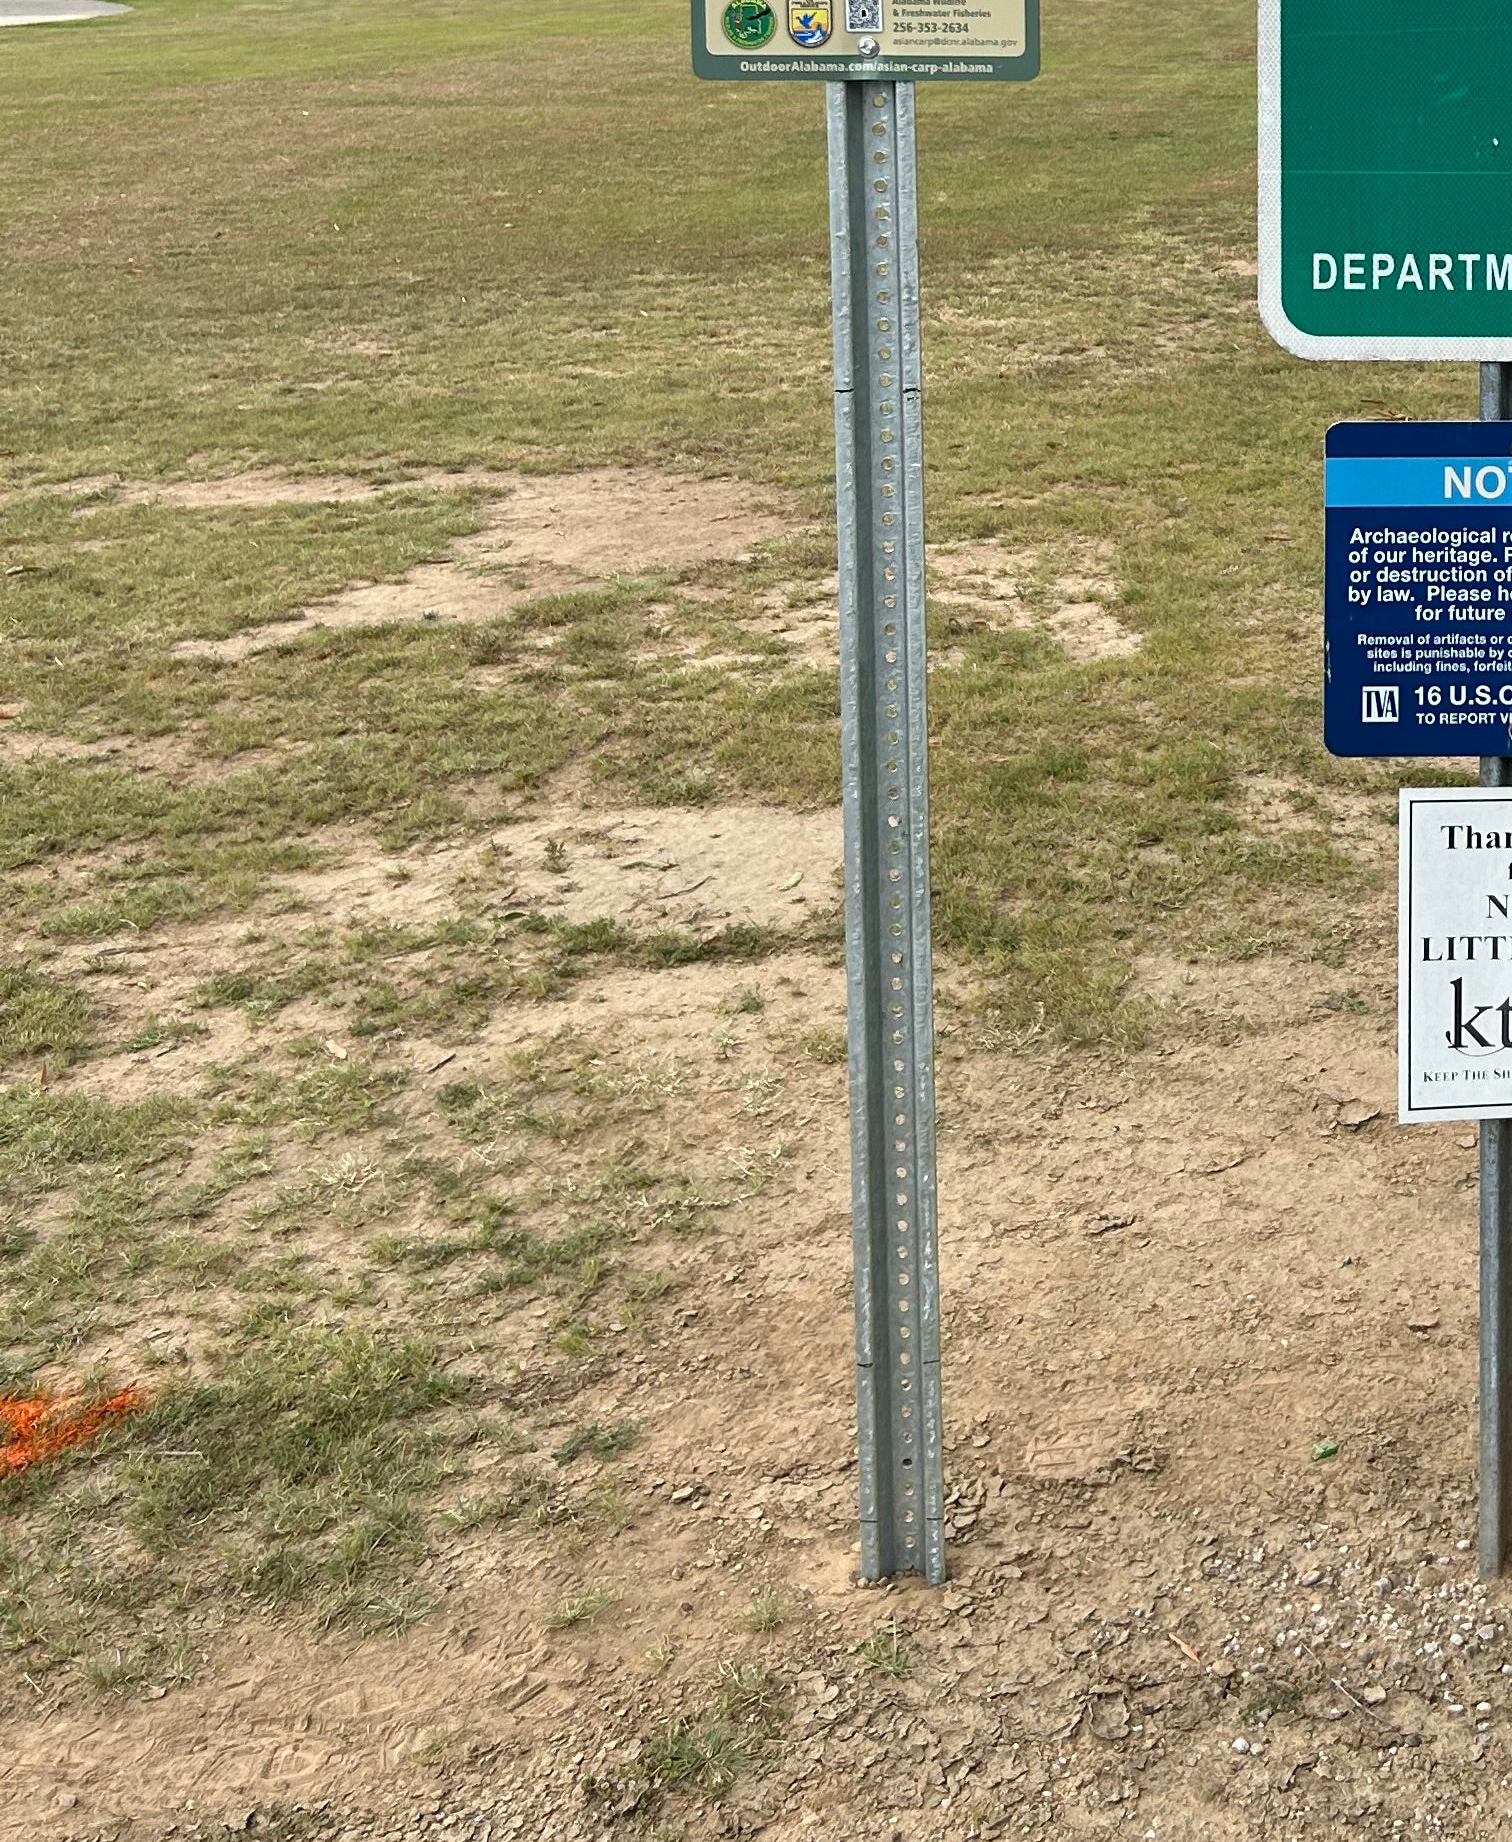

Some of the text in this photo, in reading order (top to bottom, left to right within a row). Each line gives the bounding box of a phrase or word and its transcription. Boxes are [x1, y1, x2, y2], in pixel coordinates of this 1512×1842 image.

[901, 8, 951, 17] Freshwater
[953, 9, 991, 18] Fisheries
[893, 22, 969, 33] 256-353-2634
[740, 59, 993, 75] OutdoorAlabama.com/asian-carp-alabama
[1350, 527, 1496, 547] Archaeological
[1348, 547, 1368, 563] of
[1374, 551, 1407, 563] our
[1412, 546, 1498, 566] heritage.
[1350, 570, 1371, 583] or
[1376, 566, 1487, 582] destruction
[1494, 566, 1512, 582] of
[1348, 586, 1371, 605] by
[1377, 585, 1415, 602] law.
[1427, 585, 1491, 601] Please
[1415, 605, 1443, 621] for
[1448, 605, 1505, 621] future
[1357, 634, 1413, 645] Removal
[1417, 634, 1430, 645] of
[1433, 633, 1486, 648] artifacts
[1489, 636, 1504, 648] or
[1367, 647, 1397, 659] sites
[1401, 647, 1412, 659] is
[1416, 647, 1485, 660] punishable
[1489, 647, 1504, 660] by
[1374, 661, 1432, 674] including
[1436, 661, 1470, 673] fines,
[1414, 686, 1441, 706] 16
[1416, 713, 1435, 724] TO
[1439, 712, 1496, 725] REPORT
[1423, 1071, 1459, 1083] KEEP
